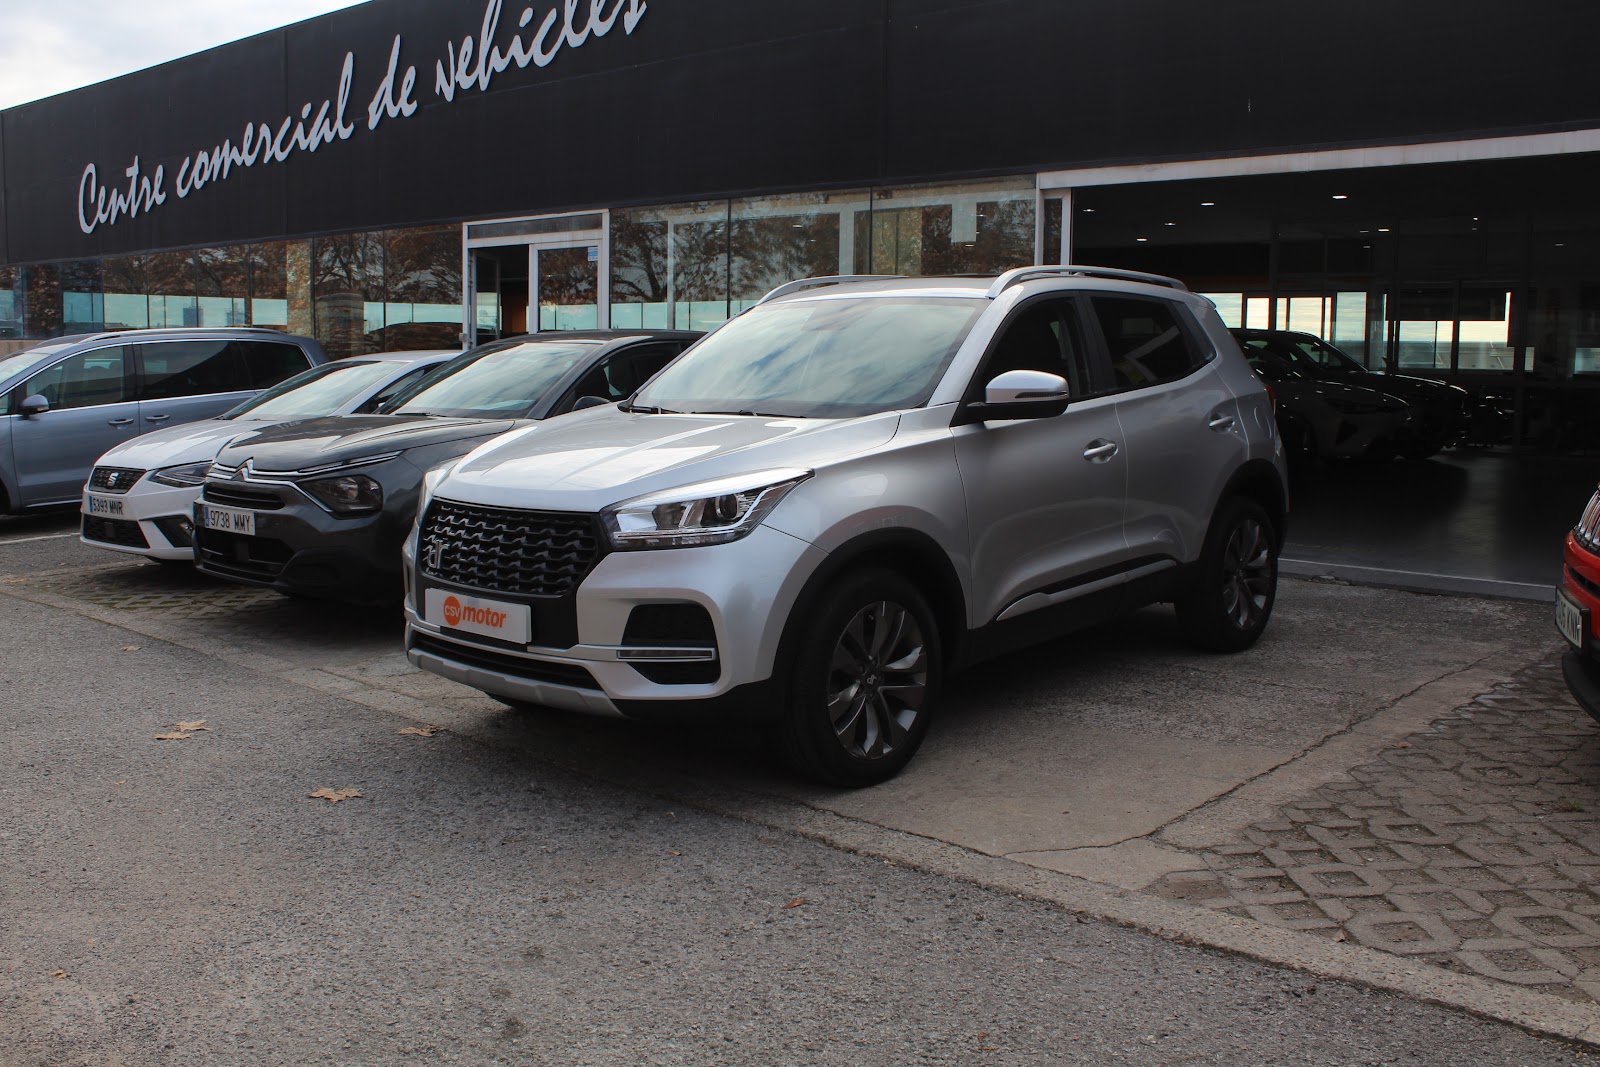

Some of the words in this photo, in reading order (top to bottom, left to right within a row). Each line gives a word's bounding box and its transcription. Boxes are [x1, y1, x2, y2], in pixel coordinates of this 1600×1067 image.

[78, 155, 167, 235] Centre
[176, 51, 355, 198] comercial
[368, 34, 418, 130] de
[92, 497, 108, 513] 5393
[210, 510, 231, 529] 9738
[233, 513, 251, 532] MMY
[444, 605, 461, 618] CSV
[462, 605, 507, 628] motor
